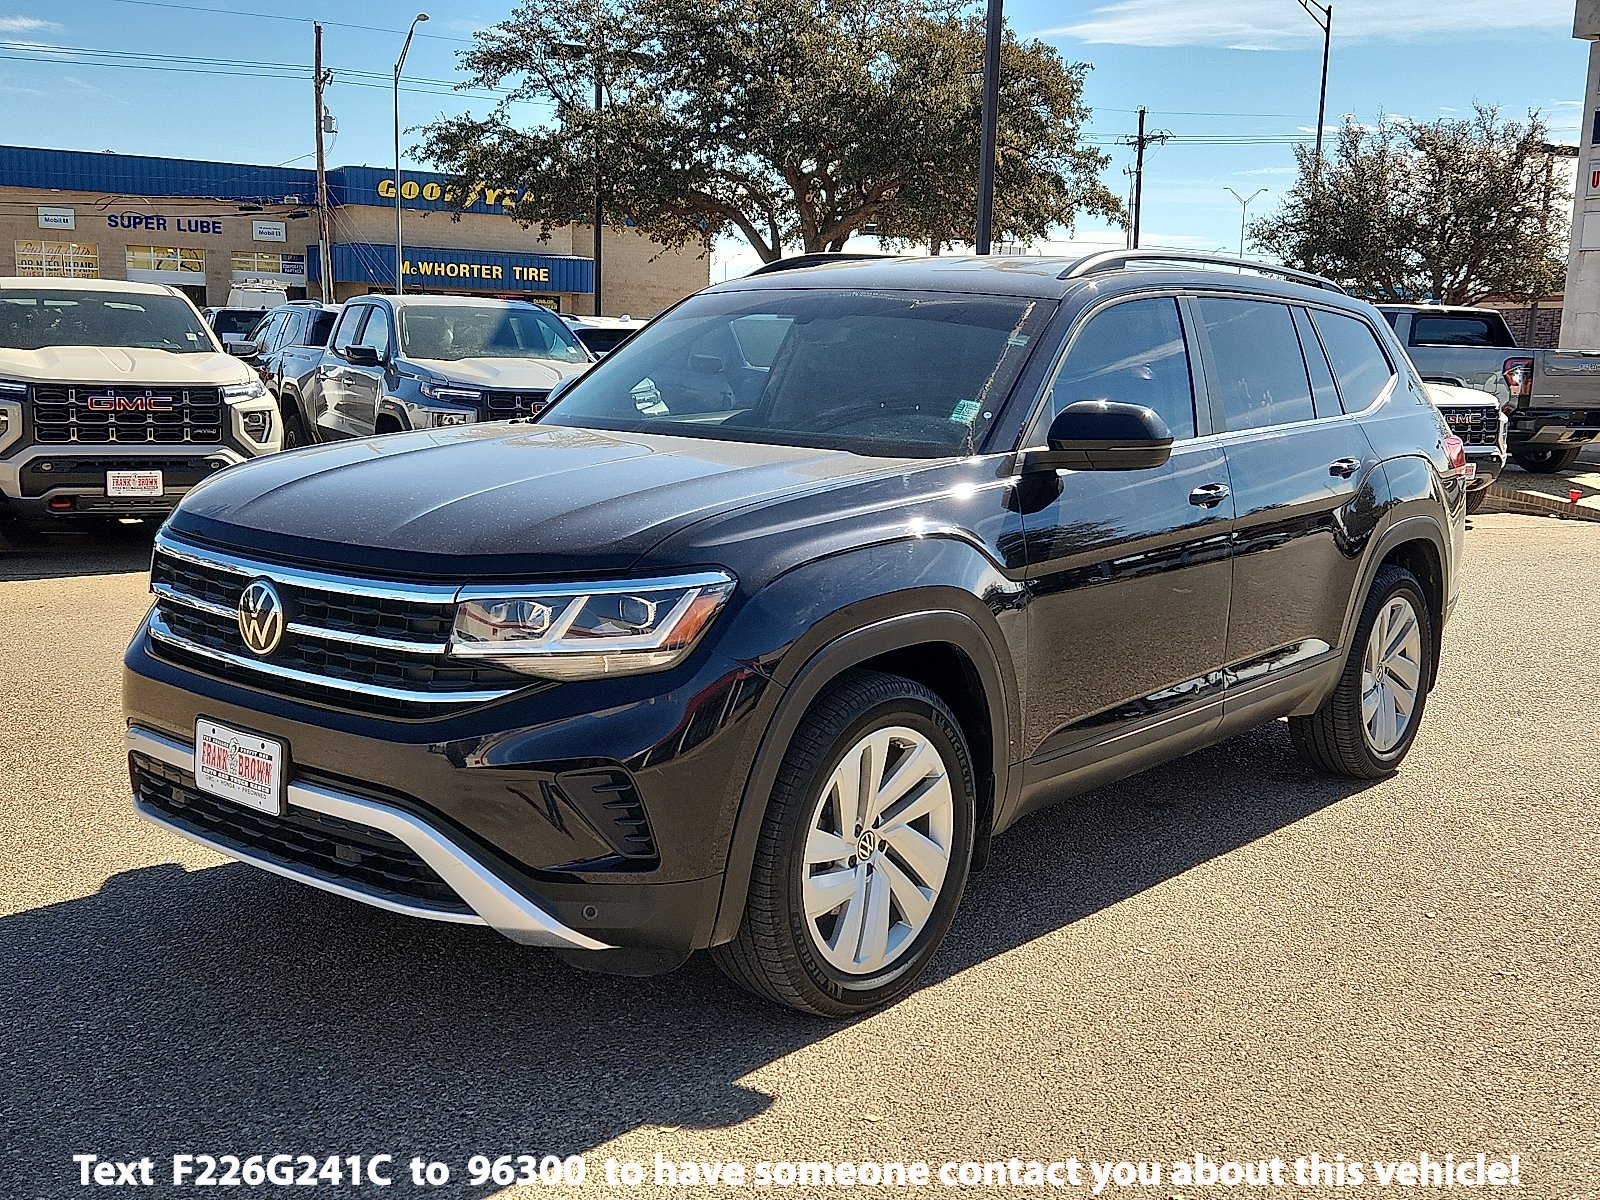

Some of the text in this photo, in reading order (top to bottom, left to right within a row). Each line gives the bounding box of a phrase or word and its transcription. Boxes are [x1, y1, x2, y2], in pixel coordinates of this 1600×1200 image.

[107, 214, 222, 234] SUPER LUBE
[258, 229, 275, 237] Mobil
[401, 260, 549, 282] McWHORTER TIRE
[87, 395, 173, 412] GMC
[1445, 413, 1482, 424] GMC
[112, 478, 158, 487] FRANK BROWN
[201, 741, 273, 787] FRANK BROWN
[202, 766, 217, 776] AUTO
[217, 772, 229, 780] AND
[229, 776, 249, 788] TRUCK
[221, 779, 236, 790] HONDA
